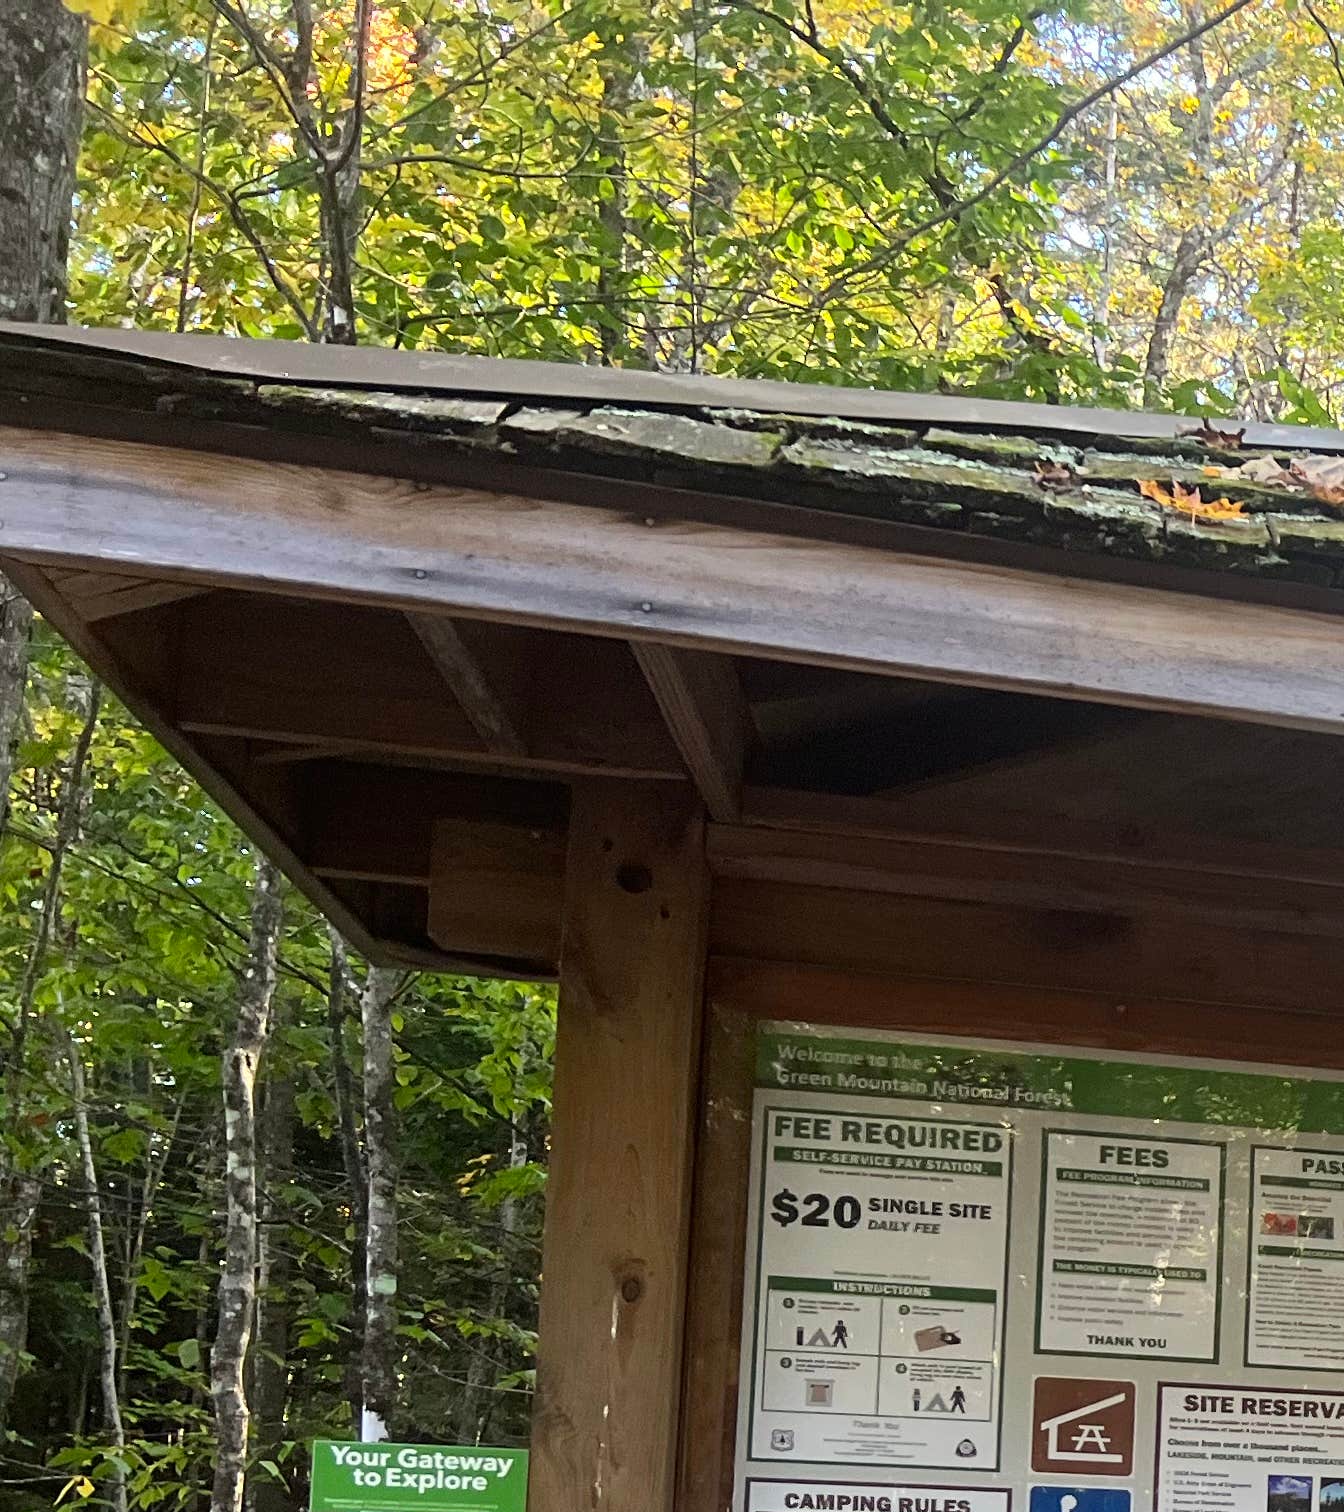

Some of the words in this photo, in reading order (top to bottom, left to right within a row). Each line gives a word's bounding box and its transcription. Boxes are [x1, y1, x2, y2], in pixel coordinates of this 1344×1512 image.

[778, 1044, 862, 1065] Welcome
[868, 1053, 887, 1067] to
[894, 1054, 924, 1070] the
[778, 1069, 832, 1087] Green
[837, 1073, 927, 1095] Mountain
[932, 1079, 1010, 1101] National
[775, 1115, 832, 1141] FEE
[841, 1119, 1003, 1153] REQUIRED
[792, 1149, 891, 1168] SELF-SERVICE
[895, 1155, 923, 1170] PAY
[1099, 1145, 1170, 1169] FEES
[770, 1188, 862, 1229] $20
[868, 1197, 943, 1217] SINGLE
[948, 1203, 992, 1220] SITE
[868, 1218, 911, 1234] DAILY
[914, 1221, 941, 1235] FEE
[832, 1281, 932, 1298] INSTRUCTIONS
[1086, 1334, 1134, 1348] THANK
[1138, 1336, 1167, 1349] YOU
[1183, 1394, 1234, 1414] SITE
[330, 1445, 392, 1468] Your
[397, 1448, 514, 1478] Gateway
[353, 1468, 383, 1488] to
[385, 1467, 489, 1494] Explore
